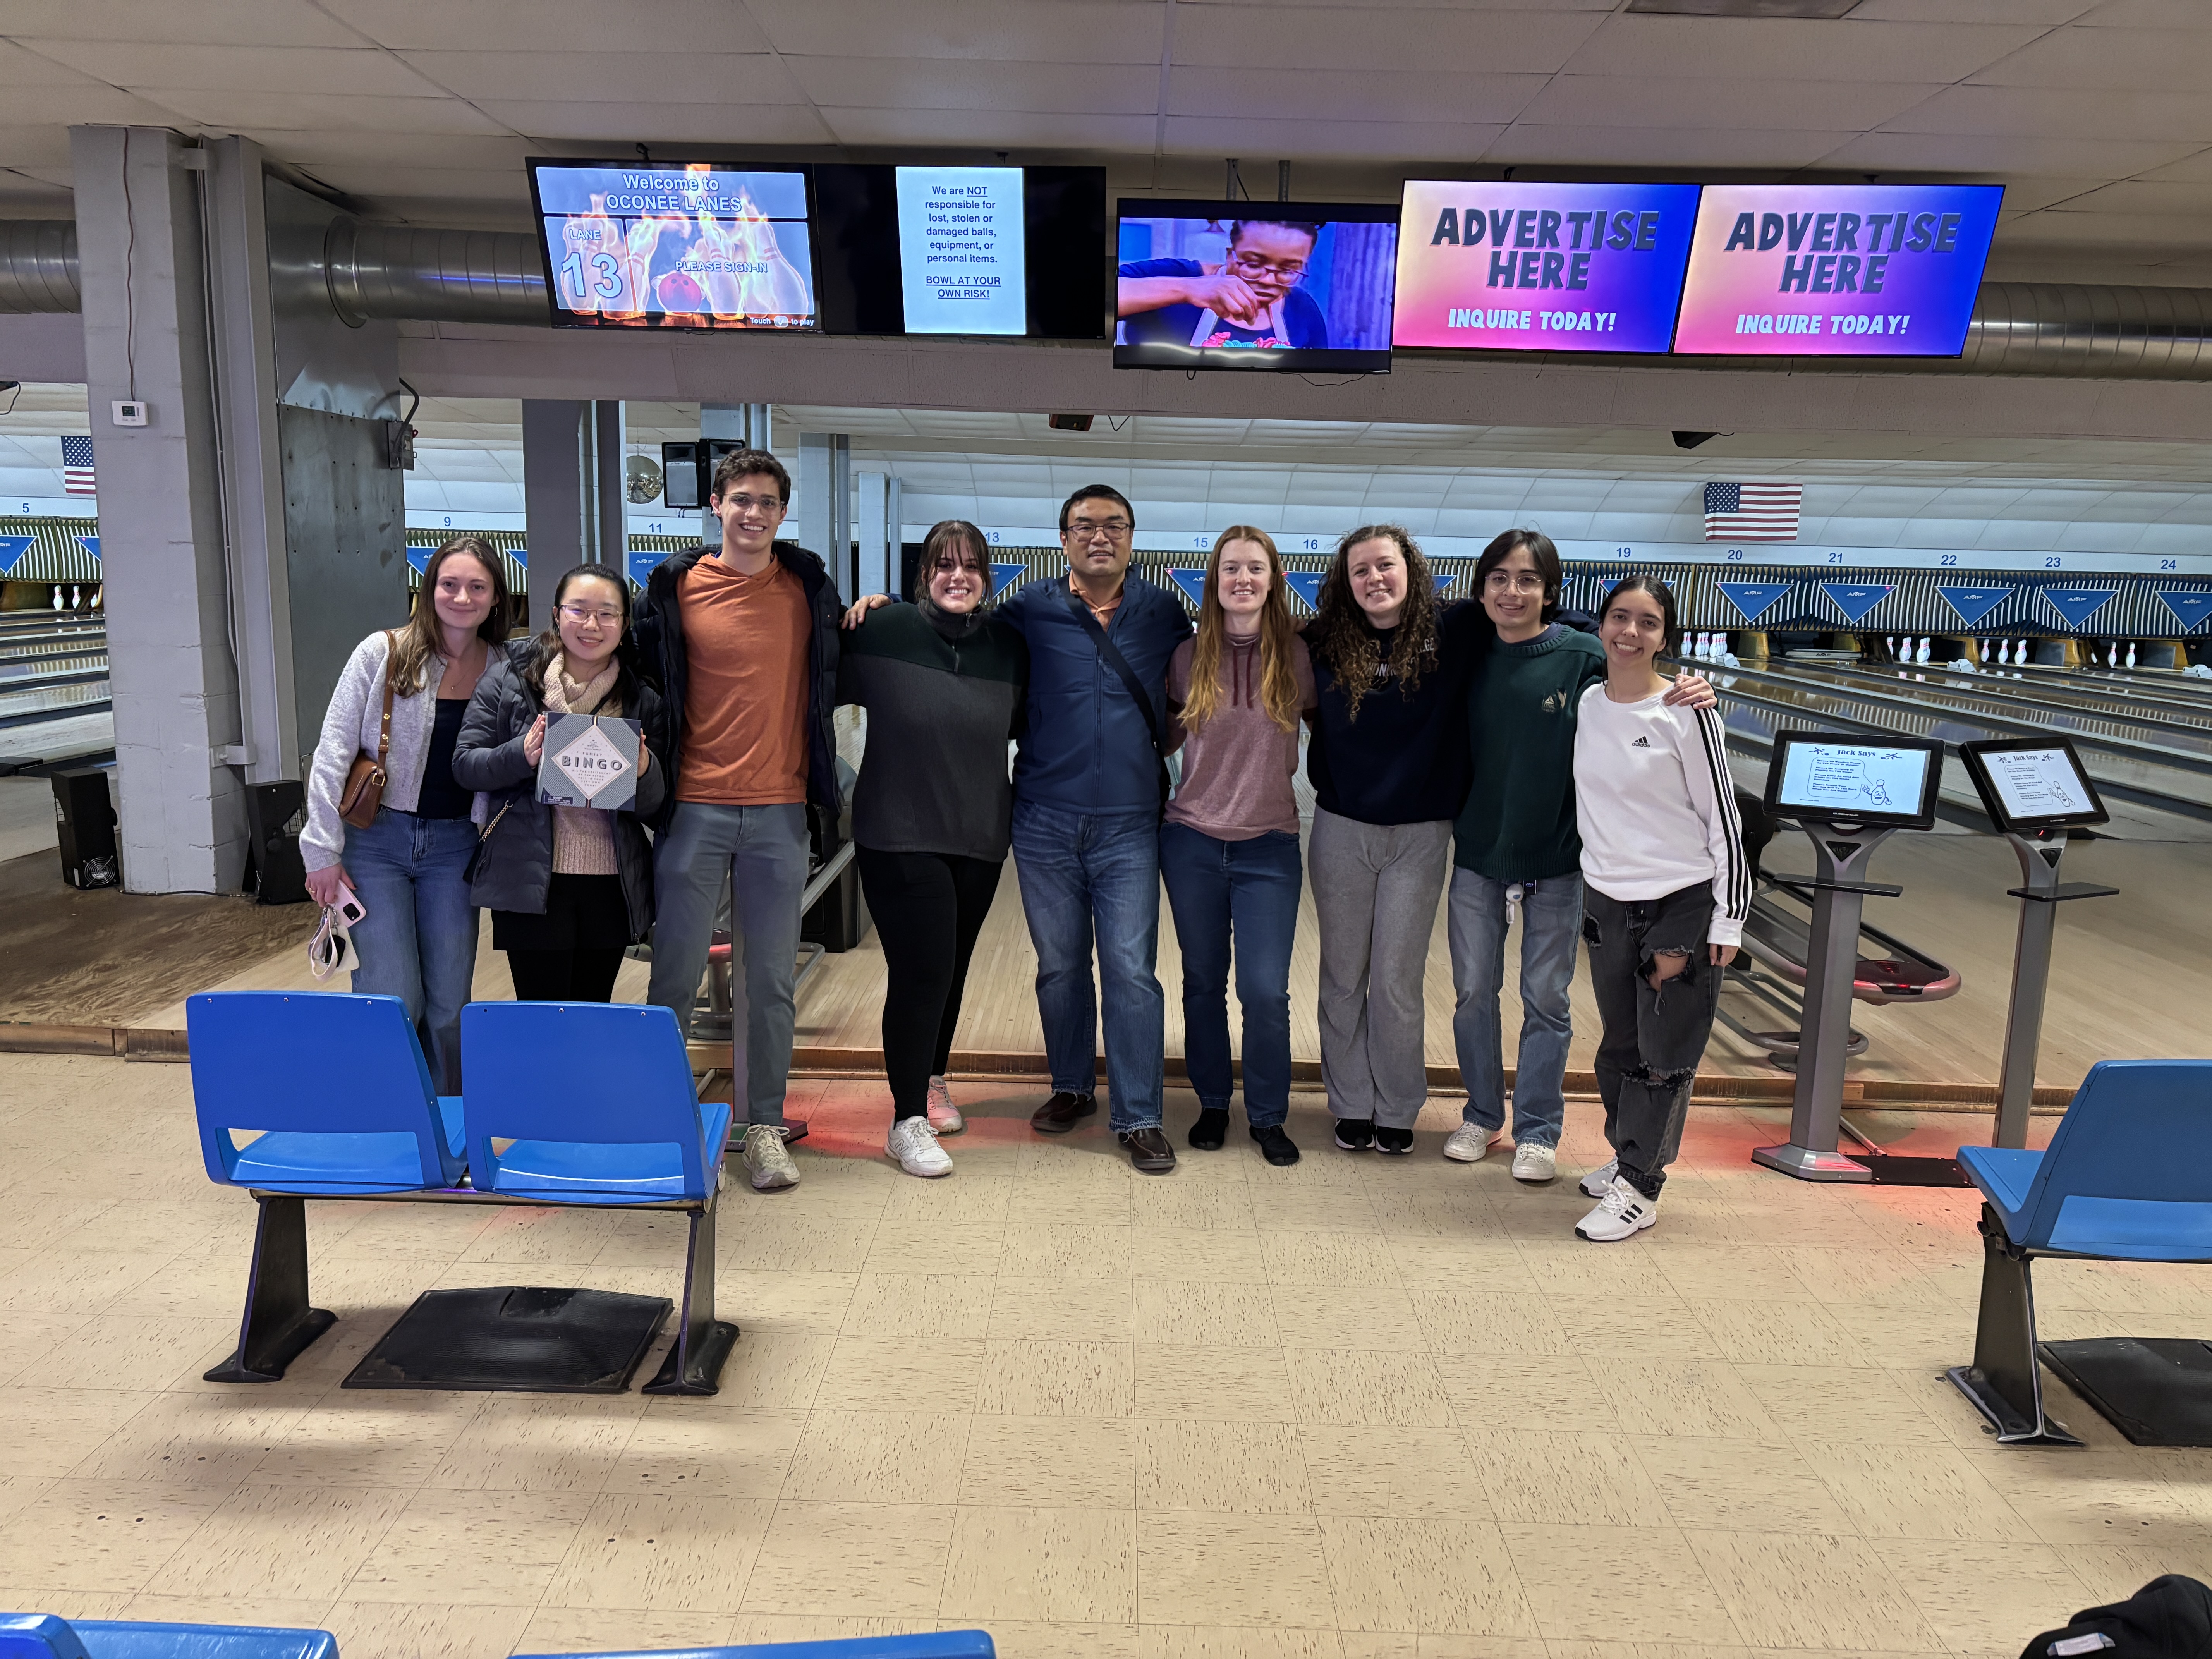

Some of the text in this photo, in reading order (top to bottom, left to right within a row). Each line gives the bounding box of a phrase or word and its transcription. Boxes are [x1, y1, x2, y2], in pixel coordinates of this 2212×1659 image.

[623, 173, 719, 191] Welcome to
[931, 186, 947, 195] We
[967, 186, 988, 197] NOT
[606, 194, 742, 212] OCONEE LANES
[925, 200, 995, 211] responsible for
[929, 213, 949, 223] lost,
[951, 213, 980, 223] stolen
[569, 229, 602, 240] LANE
[926, 227, 996, 237] damaged balls,
[1430, 207, 1660, 251] ADVERTISE
[1724, 211, 1962, 253] ADVERTISE
[929, 240, 981, 251] equipment,
[927, 254, 998, 264] personal items.
[675, 261, 768, 273] PLEASE SIGN-IN
[1486, 250, 1591, 290] HERE
[562, 253, 623, 298] 13
[1778, 254, 1890, 294] HERE
[926, 276, 1001, 287] BOWL AT YOUR
[938, 289, 990, 299] OWN RISK!
[750, 317, 771, 325] Touch
[801, 318, 814, 327] play
[1448, 308, 1617, 331] INQUIRE TODAY!
[1735, 314, 1910, 335] INQUIRE TODAY!
[22, 503, 29, 513] 5
[444, 516, 451, 527] 9
[649, 523, 662, 533] 11
[985, 532, 999, 542] 13
[1194, 537, 1208, 547] 15
[1304, 539, 1318, 550] 16
[1616, 547, 1631, 558] 19
[1728, 549, 1743, 560] 20
[1829, 553, 1843, 563] 21
[1941, 555, 1958, 566] 22
[2045, 556, 2061, 568] 23
[2161, 559, 2176, 570] 24
[562, 756, 622, 771] BINGO
